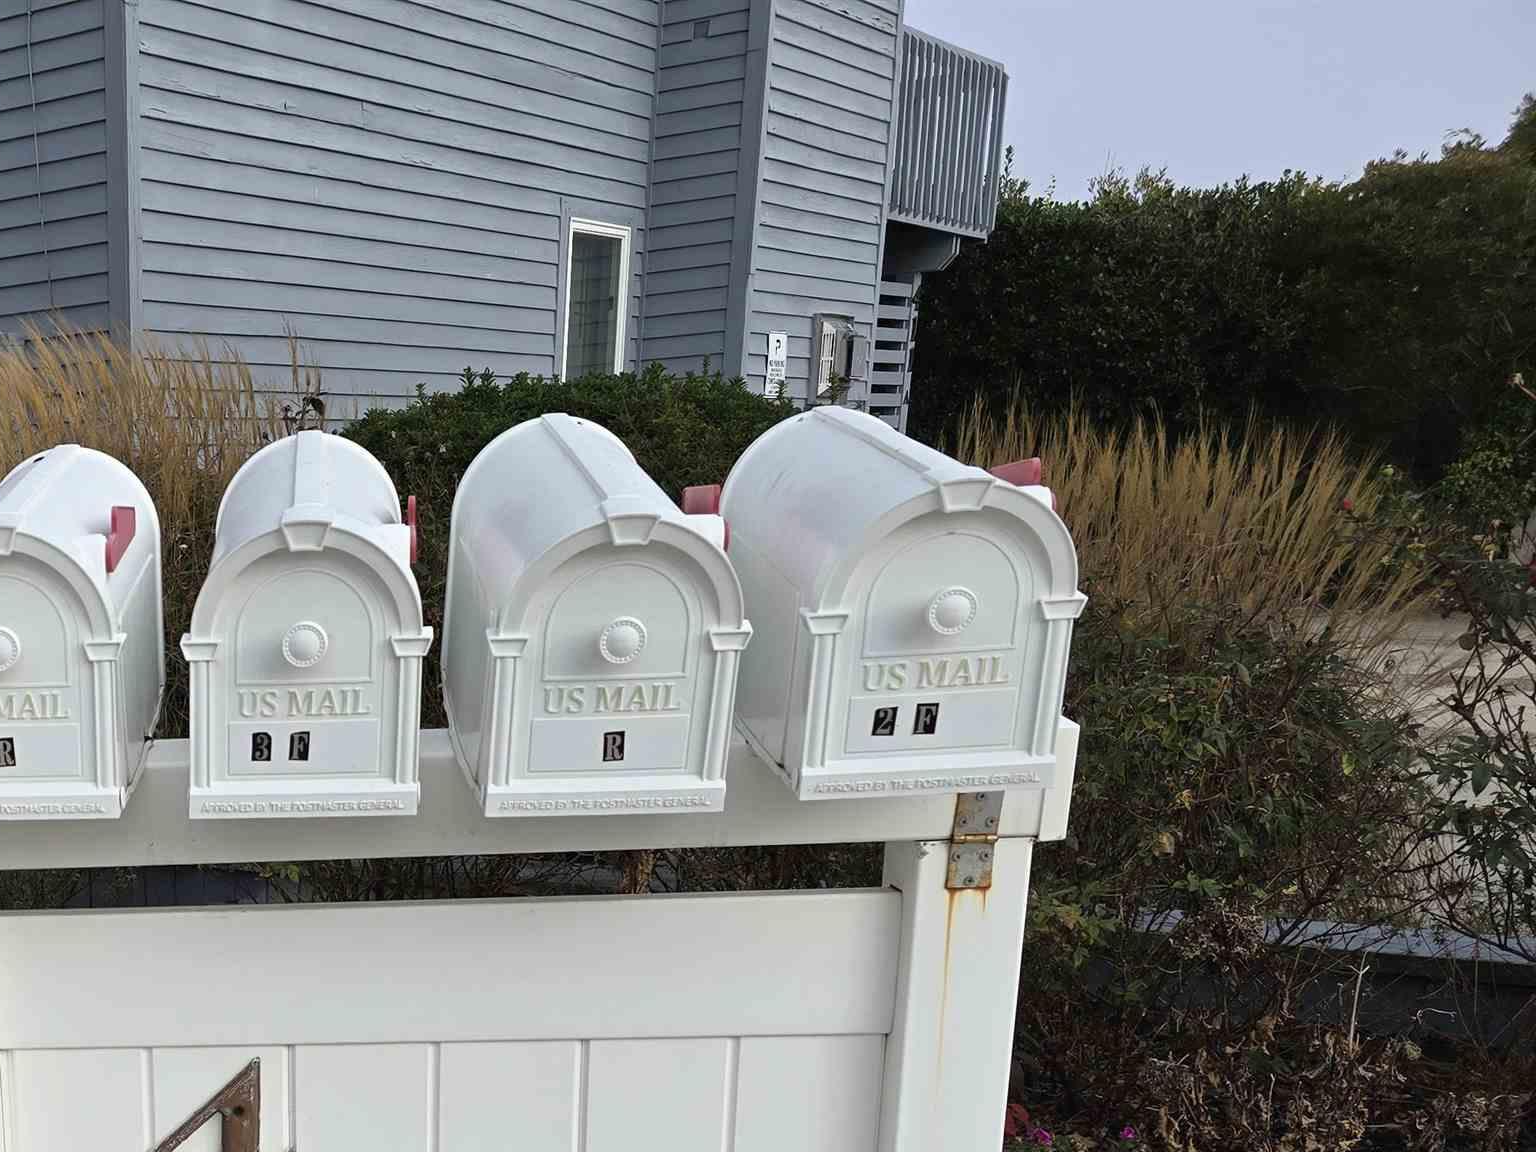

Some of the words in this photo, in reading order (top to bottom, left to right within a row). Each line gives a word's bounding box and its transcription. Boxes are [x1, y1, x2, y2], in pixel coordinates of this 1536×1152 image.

[864, 662, 907, 691] US
[915, 655, 1009, 689] MAIL
[237, 689, 279, 718] US
[287, 687, 372, 717] MAIL
[543, 686, 585, 714] US
[594, 682, 681, 713] MAIL
[874, 708, 894, 734] 2
[915, 705, 937, 733] F
[255, 734, 270, 760] 3
[291, 733, 308, 760] F
[604, 733, 623, 760] R
[889, 780, 913, 791] THE
[913, 776, 986, 790] POSTMASTER
[987, 771, 1041, 785] GENERAL
[269, 801, 292, 813] THE
[292, 800, 356, 812] POSTMASTER
[358, 799, 406, 811] GENERAL
[570, 799, 592, 810] THE
[593, 797, 662, 809] POSTMASTER
[663, 795, 712, 808] GENERAL
